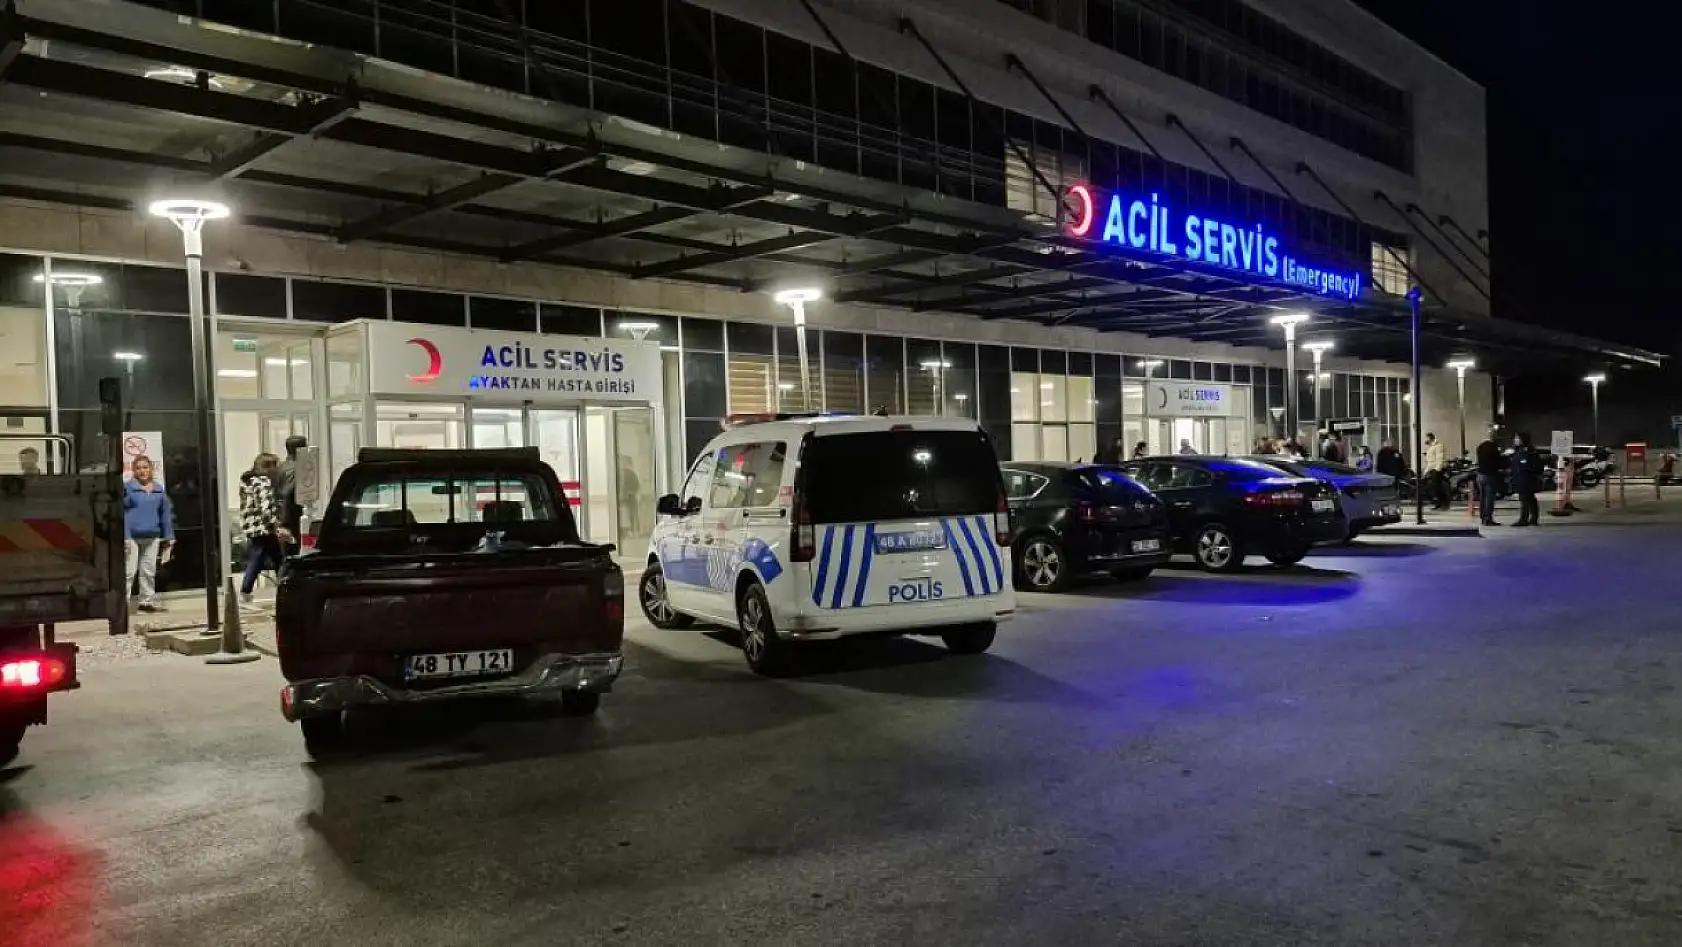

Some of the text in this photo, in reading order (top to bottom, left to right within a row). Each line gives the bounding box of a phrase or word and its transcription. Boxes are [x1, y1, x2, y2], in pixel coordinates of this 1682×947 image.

[1102, 192, 1178, 255] ACİL
[1184, 214, 1279, 277] SERVİS
[481, 340, 625, 373] ACİL SERVİS
[468, 375, 541, 391] AYAKTAN
[547, 376, 594, 393] HASTA
[414, 650, 510, 673] 48 TY 121
